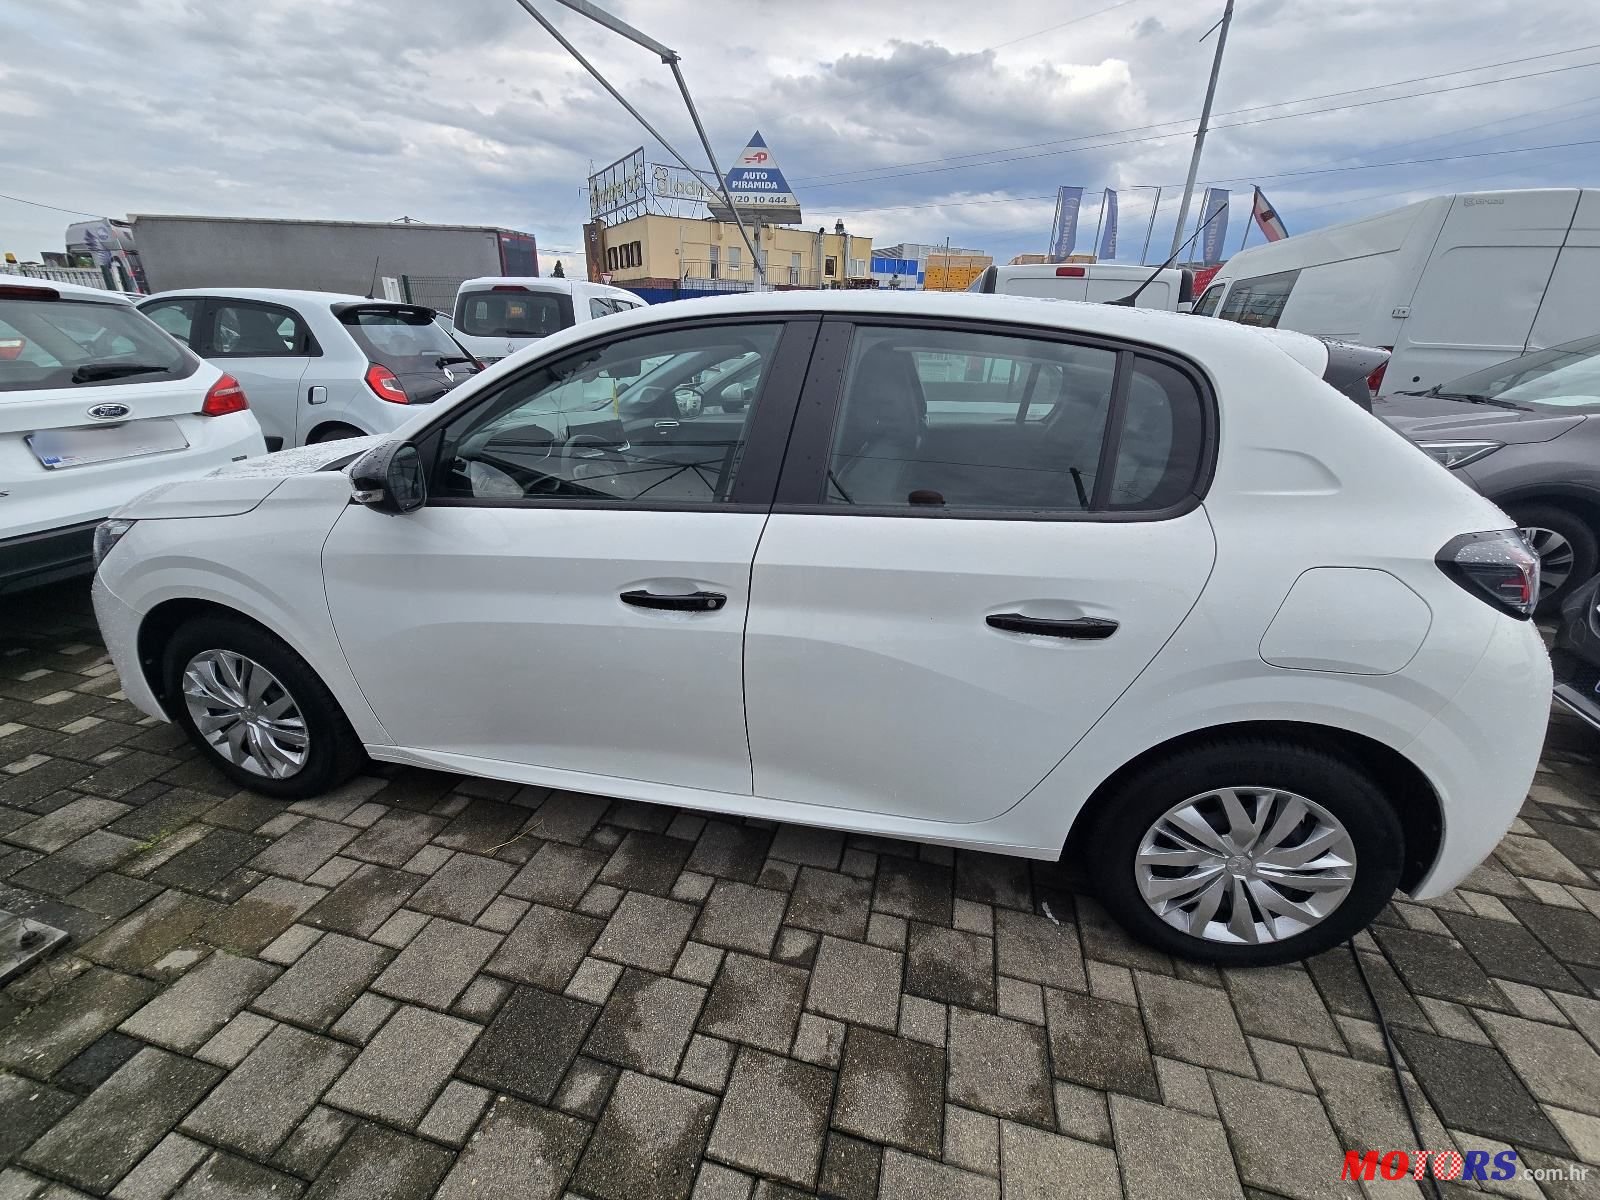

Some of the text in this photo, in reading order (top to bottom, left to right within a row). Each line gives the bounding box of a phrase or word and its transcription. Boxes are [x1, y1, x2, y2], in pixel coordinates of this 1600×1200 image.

[742, 171, 768, 180] AUTO
[732, 181, 778, 189] PIRAMIDA
[768, 196, 787, 204] 444
[1060, 215, 1073, 257] STRIDON
[99, 407, 122, 416] Ford
